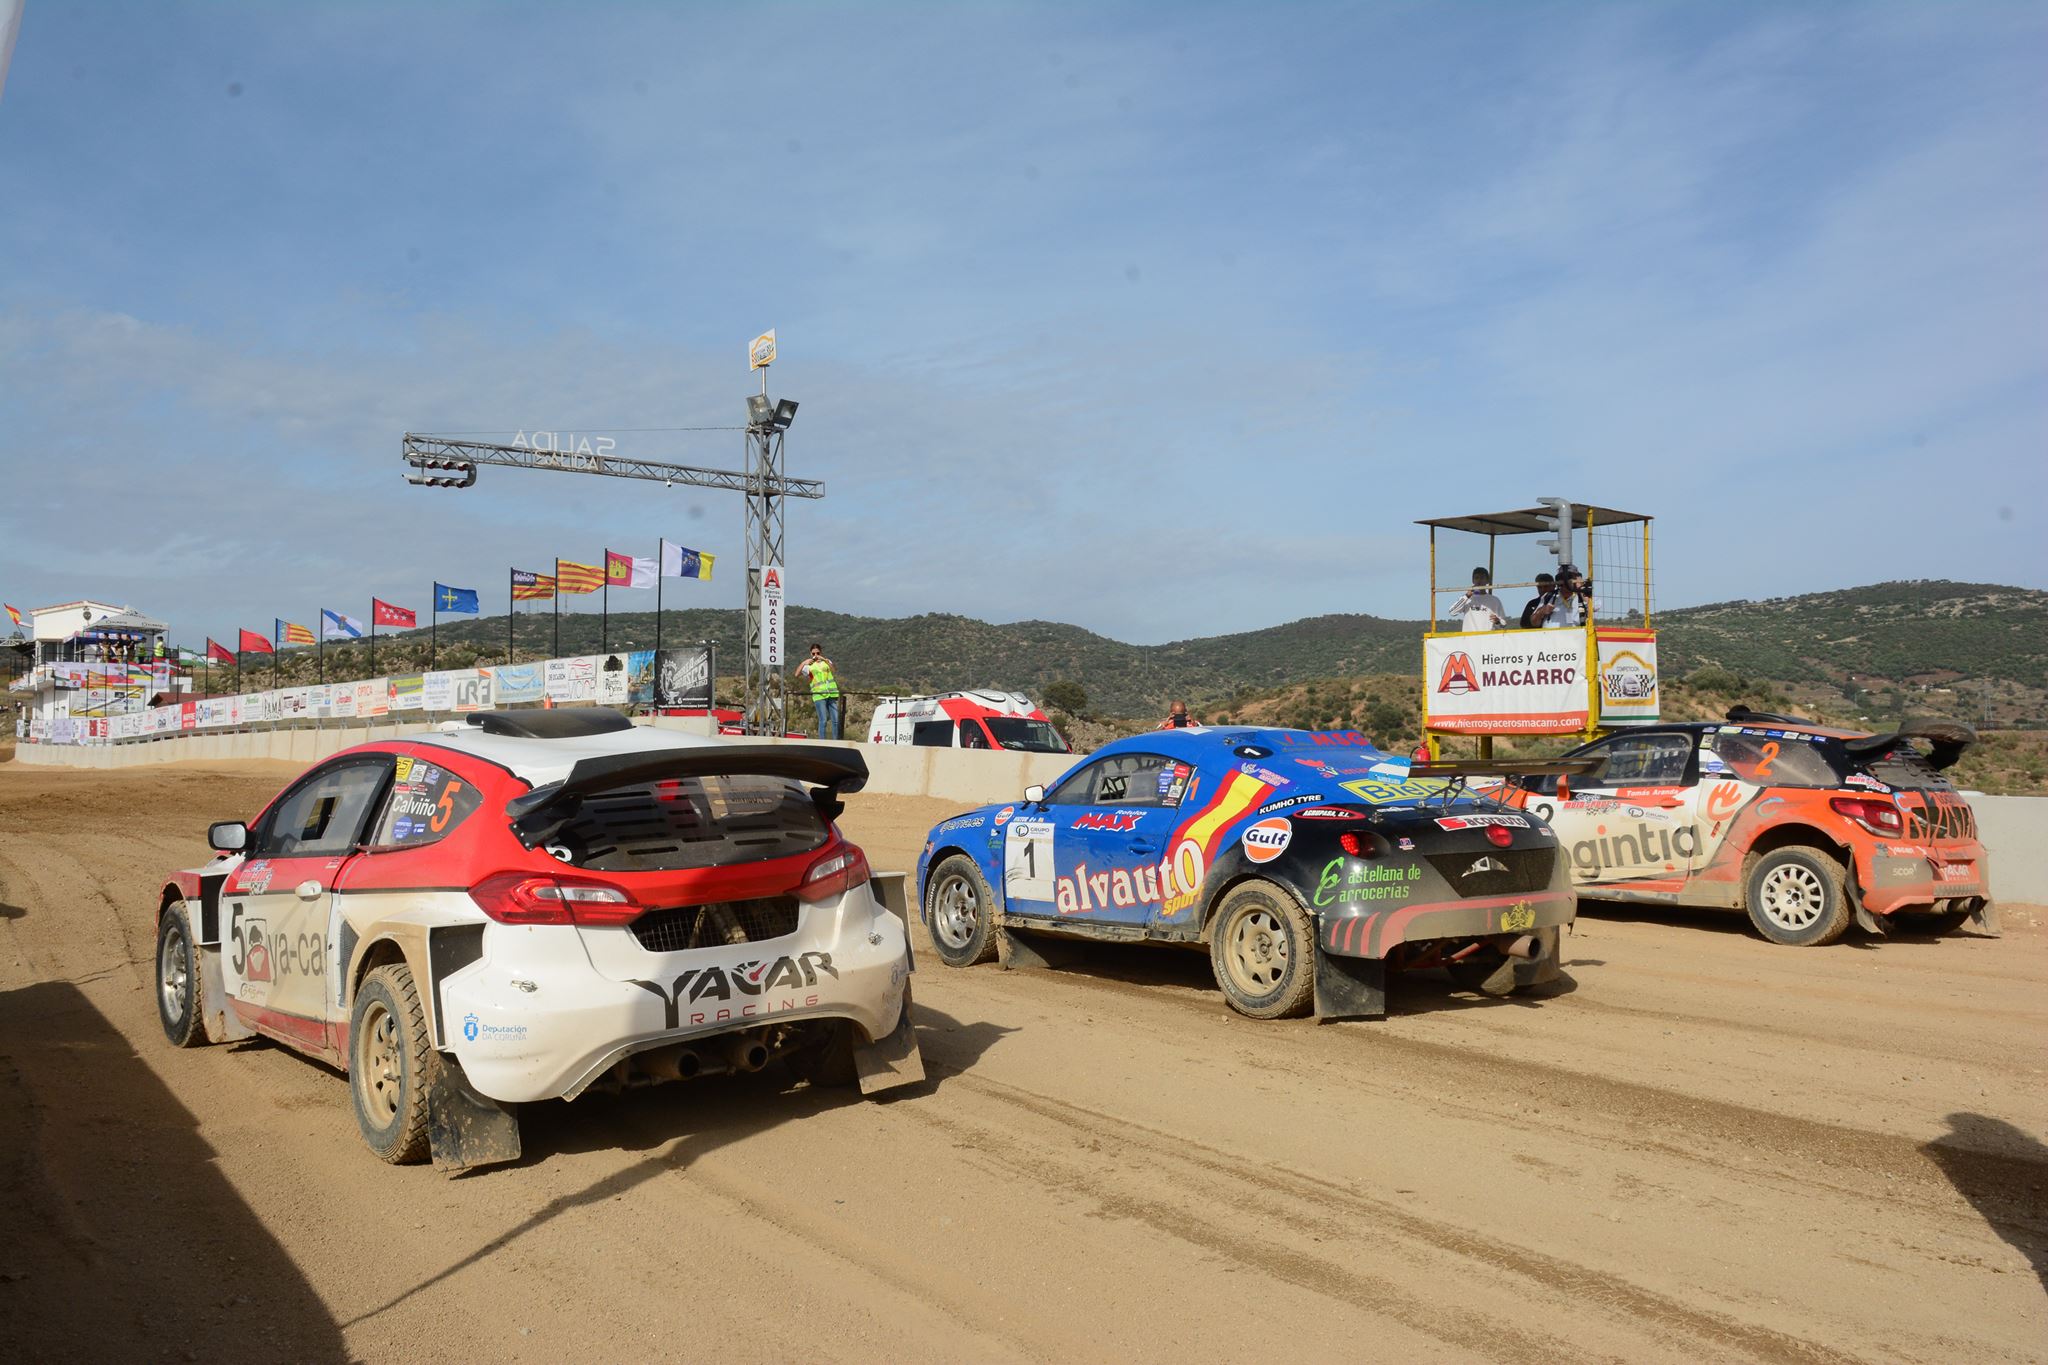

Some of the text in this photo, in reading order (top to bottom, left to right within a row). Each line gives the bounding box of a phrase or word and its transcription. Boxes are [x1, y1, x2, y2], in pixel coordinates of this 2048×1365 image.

[534, 449, 600, 471] SALIDA
[768, 599, 778, 663] MACARRO
[1482, 652, 1577, 666] Hierros y Aceros
[1482, 668, 1575, 687] MACARRO
[906, 710, 936, 718] AMBULANCIA
[898, 733, 912, 743] Roja
[1754, 742, 1779, 776] 2
[1190, 777, 1200, 800] 1
[1652, 788, 1679, 796] Aranda
[392, 795, 437, 816] Calviño
[431, 781, 462, 832] 5
[1259, 794, 1322, 814] KUMHO TYRE
[1071, 812, 1142, 832] MAX
[1245, 829, 1287, 845] Gulf
[1024, 839, 1036, 878] 1
[1561, 823, 1703, 880] gintia
[1408, 863, 1421, 880] de
[232, 903, 245, 975] 5
[621, 952, 839, 1029] YACAR
[690, 995, 819, 1024] RACING
[482, 1024, 527, 1033] Deputación
